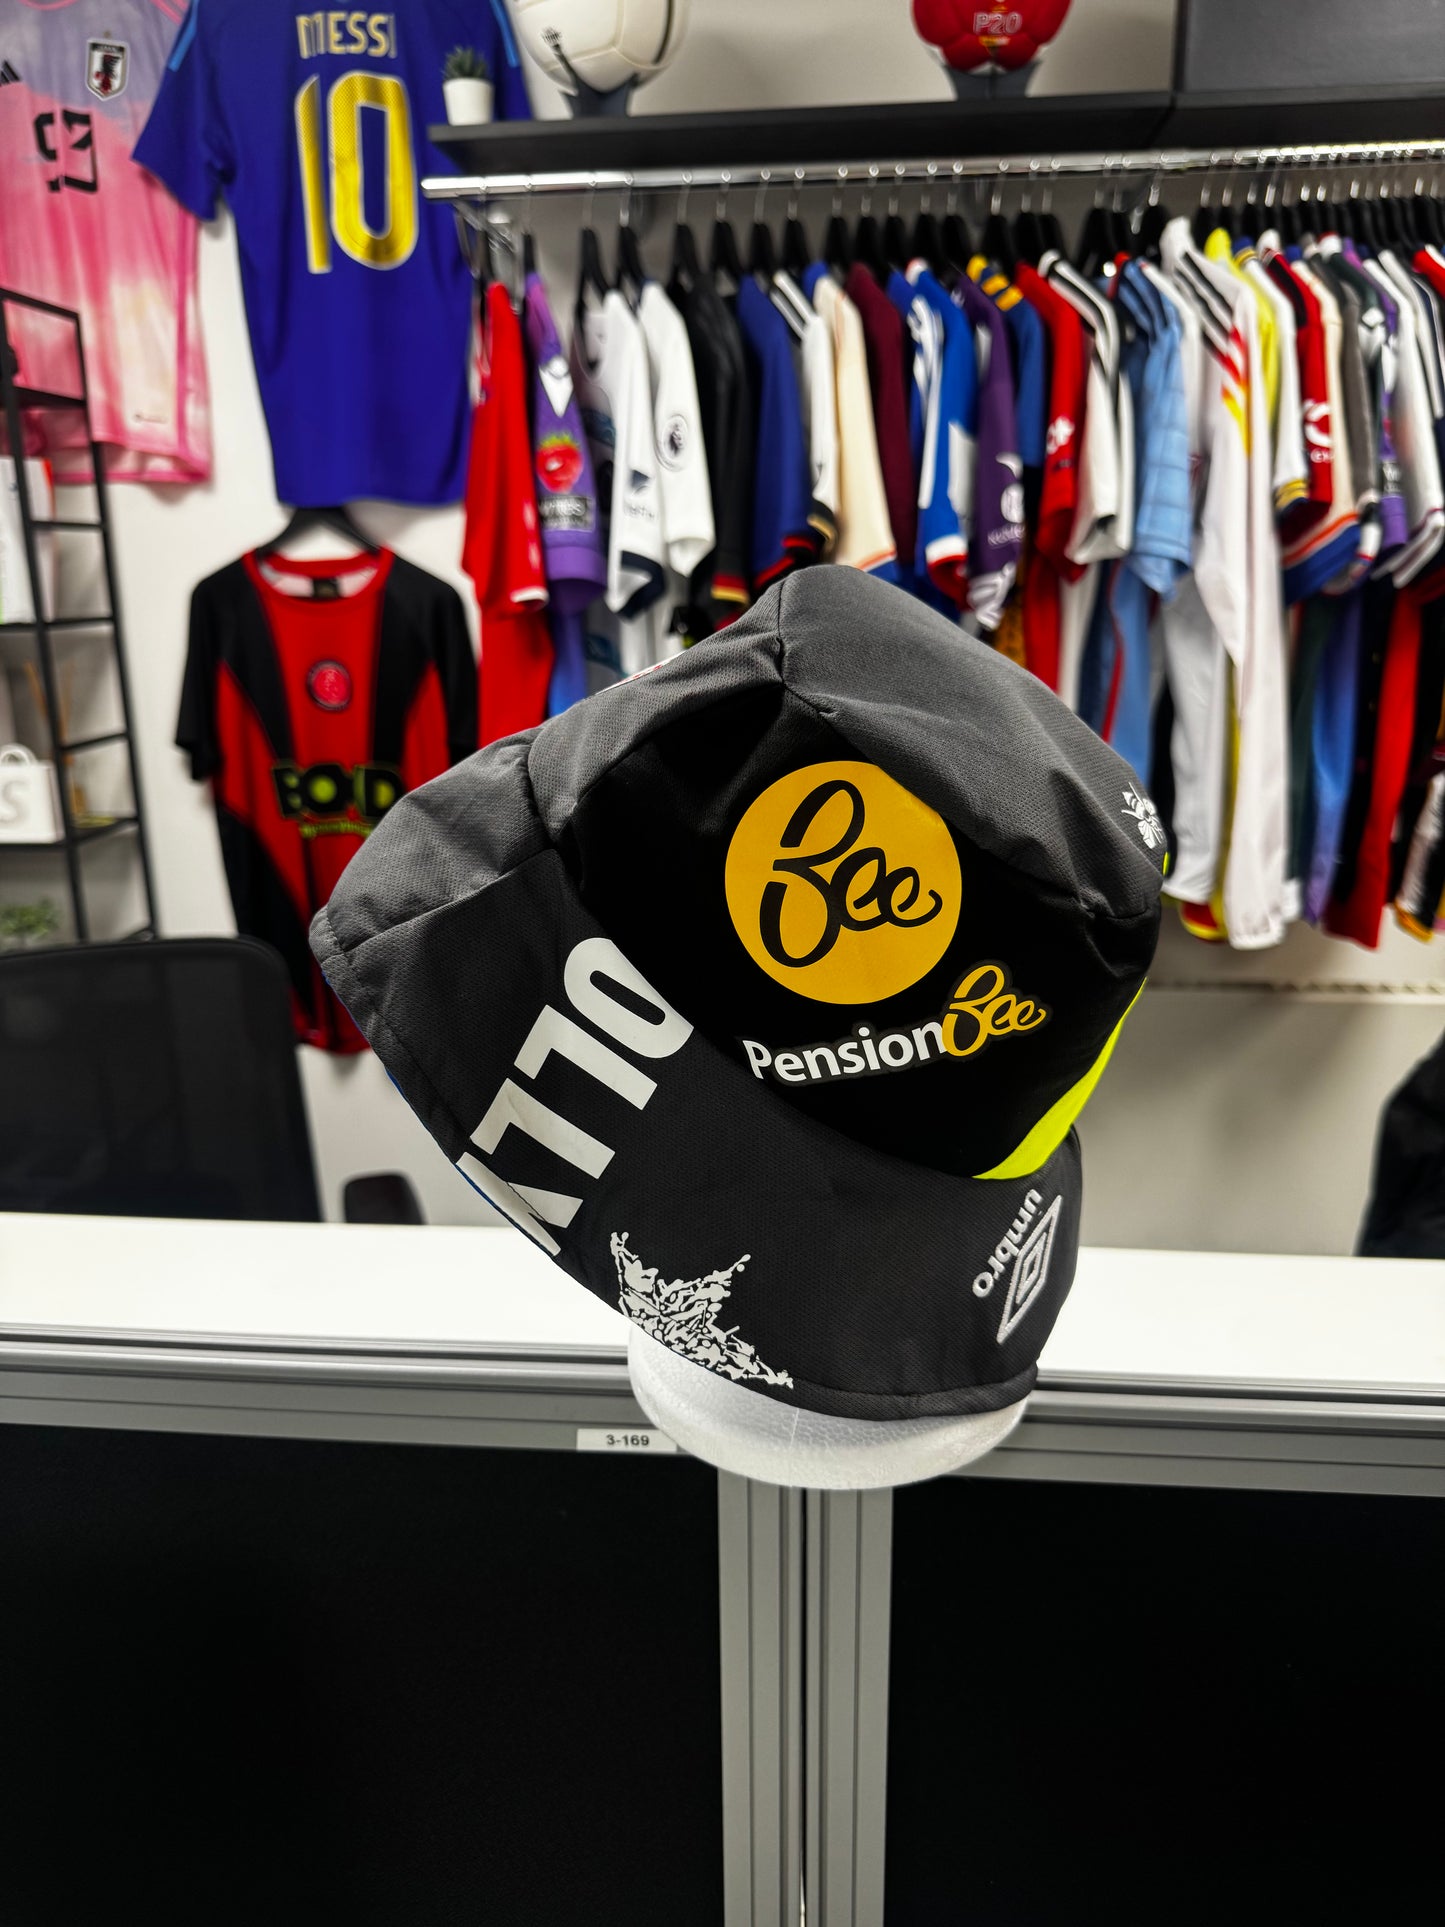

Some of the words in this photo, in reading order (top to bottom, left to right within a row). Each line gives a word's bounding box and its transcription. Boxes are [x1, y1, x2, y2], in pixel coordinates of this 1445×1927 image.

[296, 11, 398, 59] MESSI
[973, 12, 1022, 34] P20
[294, 71, 419, 274] 10
[273, 764, 406, 819] BOD
[759, 779, 943, 969] Bee
[455, 937, 694, 1257] OLLY
[972, 1188, 1043, 1298] umbro
[606, 1434, 650, 1446] 3-169
